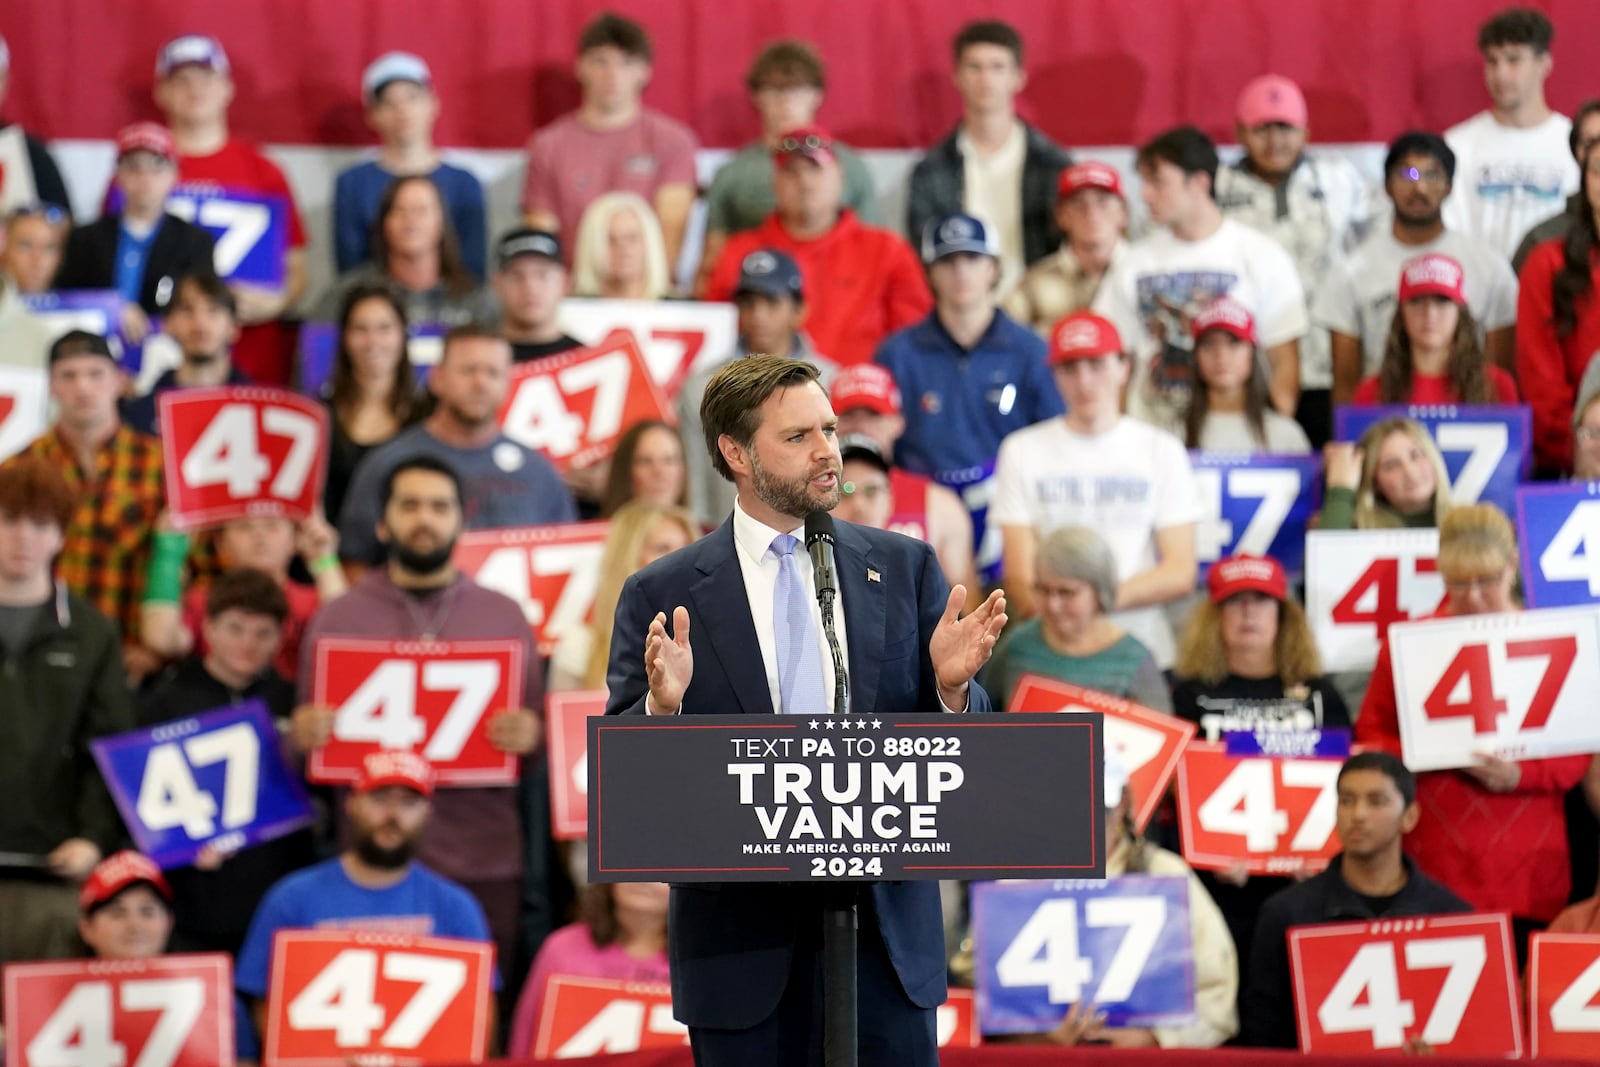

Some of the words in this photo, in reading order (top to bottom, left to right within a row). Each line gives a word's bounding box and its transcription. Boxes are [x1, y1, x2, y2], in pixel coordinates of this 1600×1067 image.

[182, 404, 318, 497] 47
[502, 350, 632, 457] 47
[1436, 423, 1508, 506] 7
[474, 541, 606, 638] 47
[1539, 499, 1600, 597] 4
[333, 660, 499, 760] 47
[1423, 636, 1578, 735] 47
[136, 723, 260, 840] 47
[727, 762, 965, 804] TRUMP
[731, 738, 794, 758] TEXT
[802, 737, 836, 757] PA
[842, 737, 876, 757] TO
[883, 737, 961, 756] 88022
[742, 844, 781, 854] MAKE
[786, 843, 848, 853] AMERICA
[853, 843, 898, 853] GREAT
[902, 842, 951, 853] AGAIN!
[754, 804, 938, 839] VANCE
[1198, 757, 1345, 852] 47
[810, 857, 883, 877] 2024
[995, 896, 1168, 1004] 47
[1318, 936, 1487, 1048] 47
[26, 977, 206, 1067] 47
[288, 949, 467, 1048] 47
